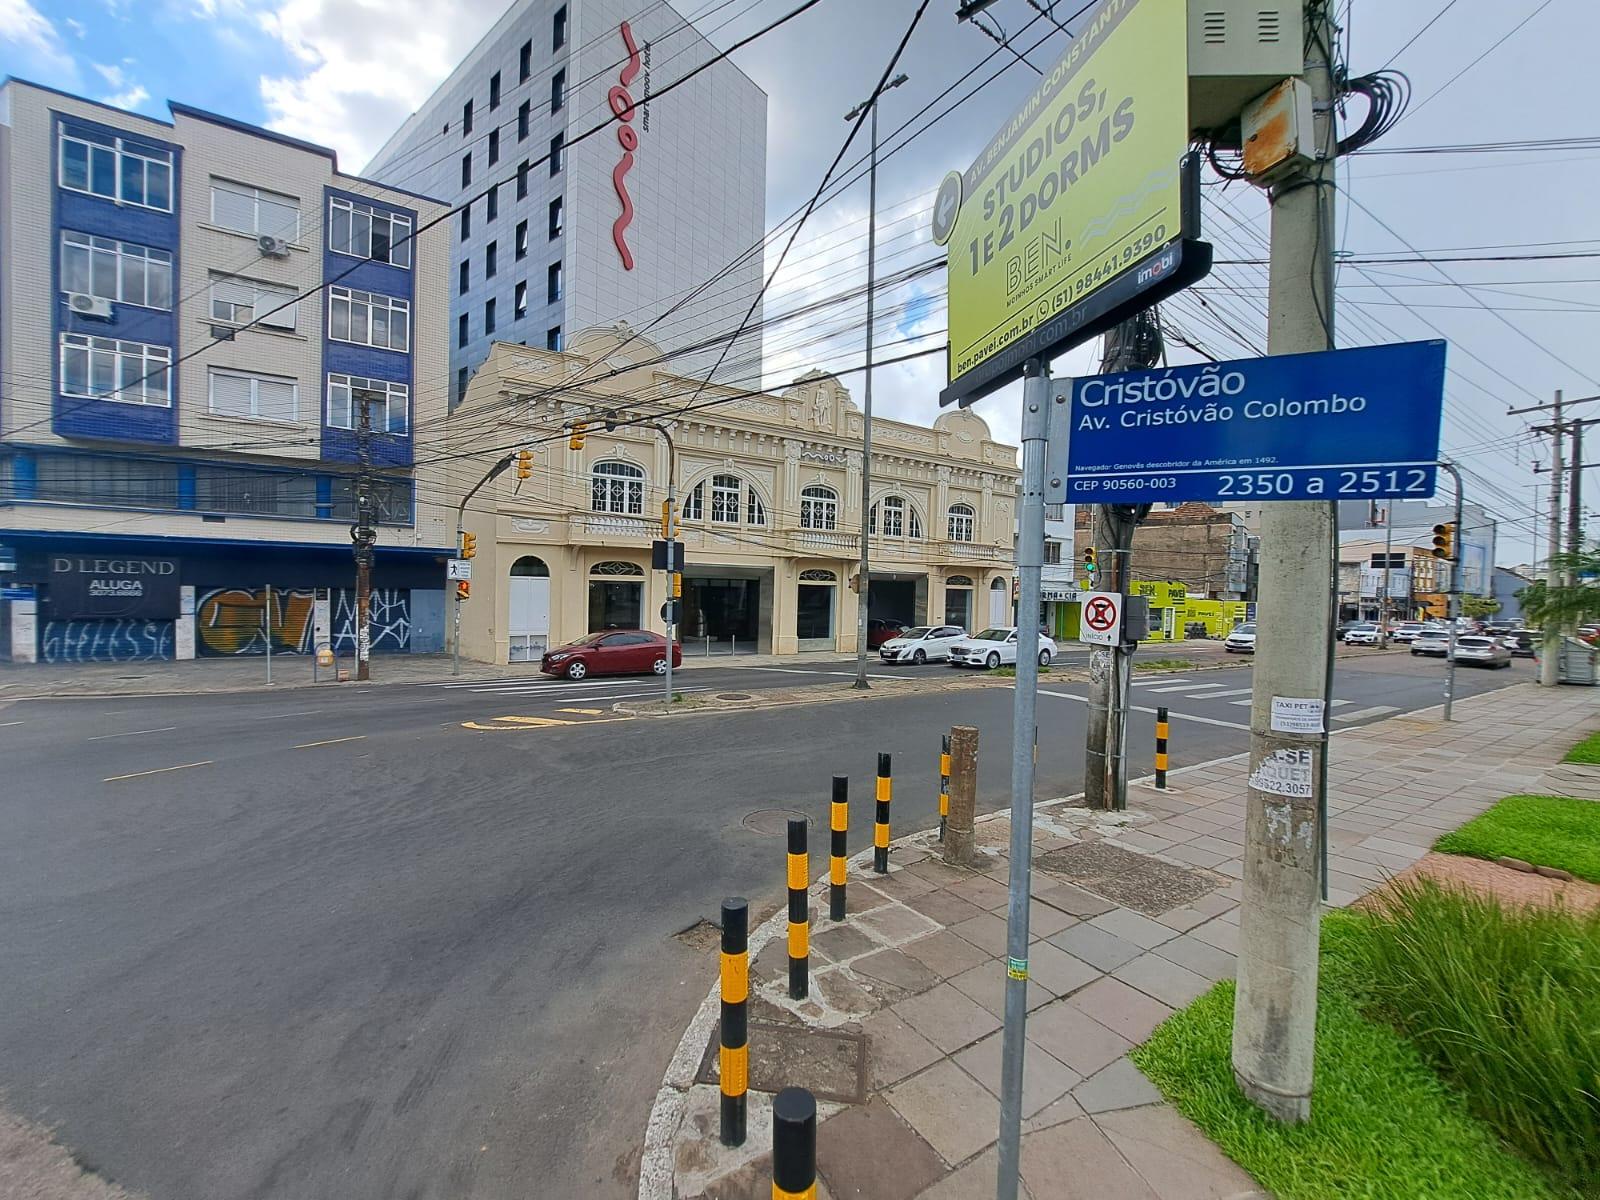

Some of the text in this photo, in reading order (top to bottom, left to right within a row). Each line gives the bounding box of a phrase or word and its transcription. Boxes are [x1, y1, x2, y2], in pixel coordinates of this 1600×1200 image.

[969, 159, 986, 186] AV.
[986, 88, 1041, 165] BENJAMIN
[983, 79, 1107, 221] STUDIOS,
[969, 97, 1135, 276] 1 E 2 DORMS
[1006, 253, 1072, 308] MOINHOS SMART LIFE
[1137, 252, 1173, 285] imobi
[957, 224, 1166, 373] ben.pavei.com.br (51) 98441.9390
[1080, 365, 1246, 407] Cristóvão
[1078, 393, 1367, 431] Av. Cristóvão Colombo
[1075, 464, 1112, 472] Navegador
[1113, 462, 1145, 471] Genovês
[1146, 460, 1190, 470] descobridor
[1203, 457, 1237, 467] América
[1074, 477, 1177, 491] CEP 90560-003
[1217, 469, 1427, 496] 2350 a 2512
[79, 559, 175, 575] LEGEND
[89, 579, 143, 590] ALUGA
[1275, 701, 1293, 709] TAXI
